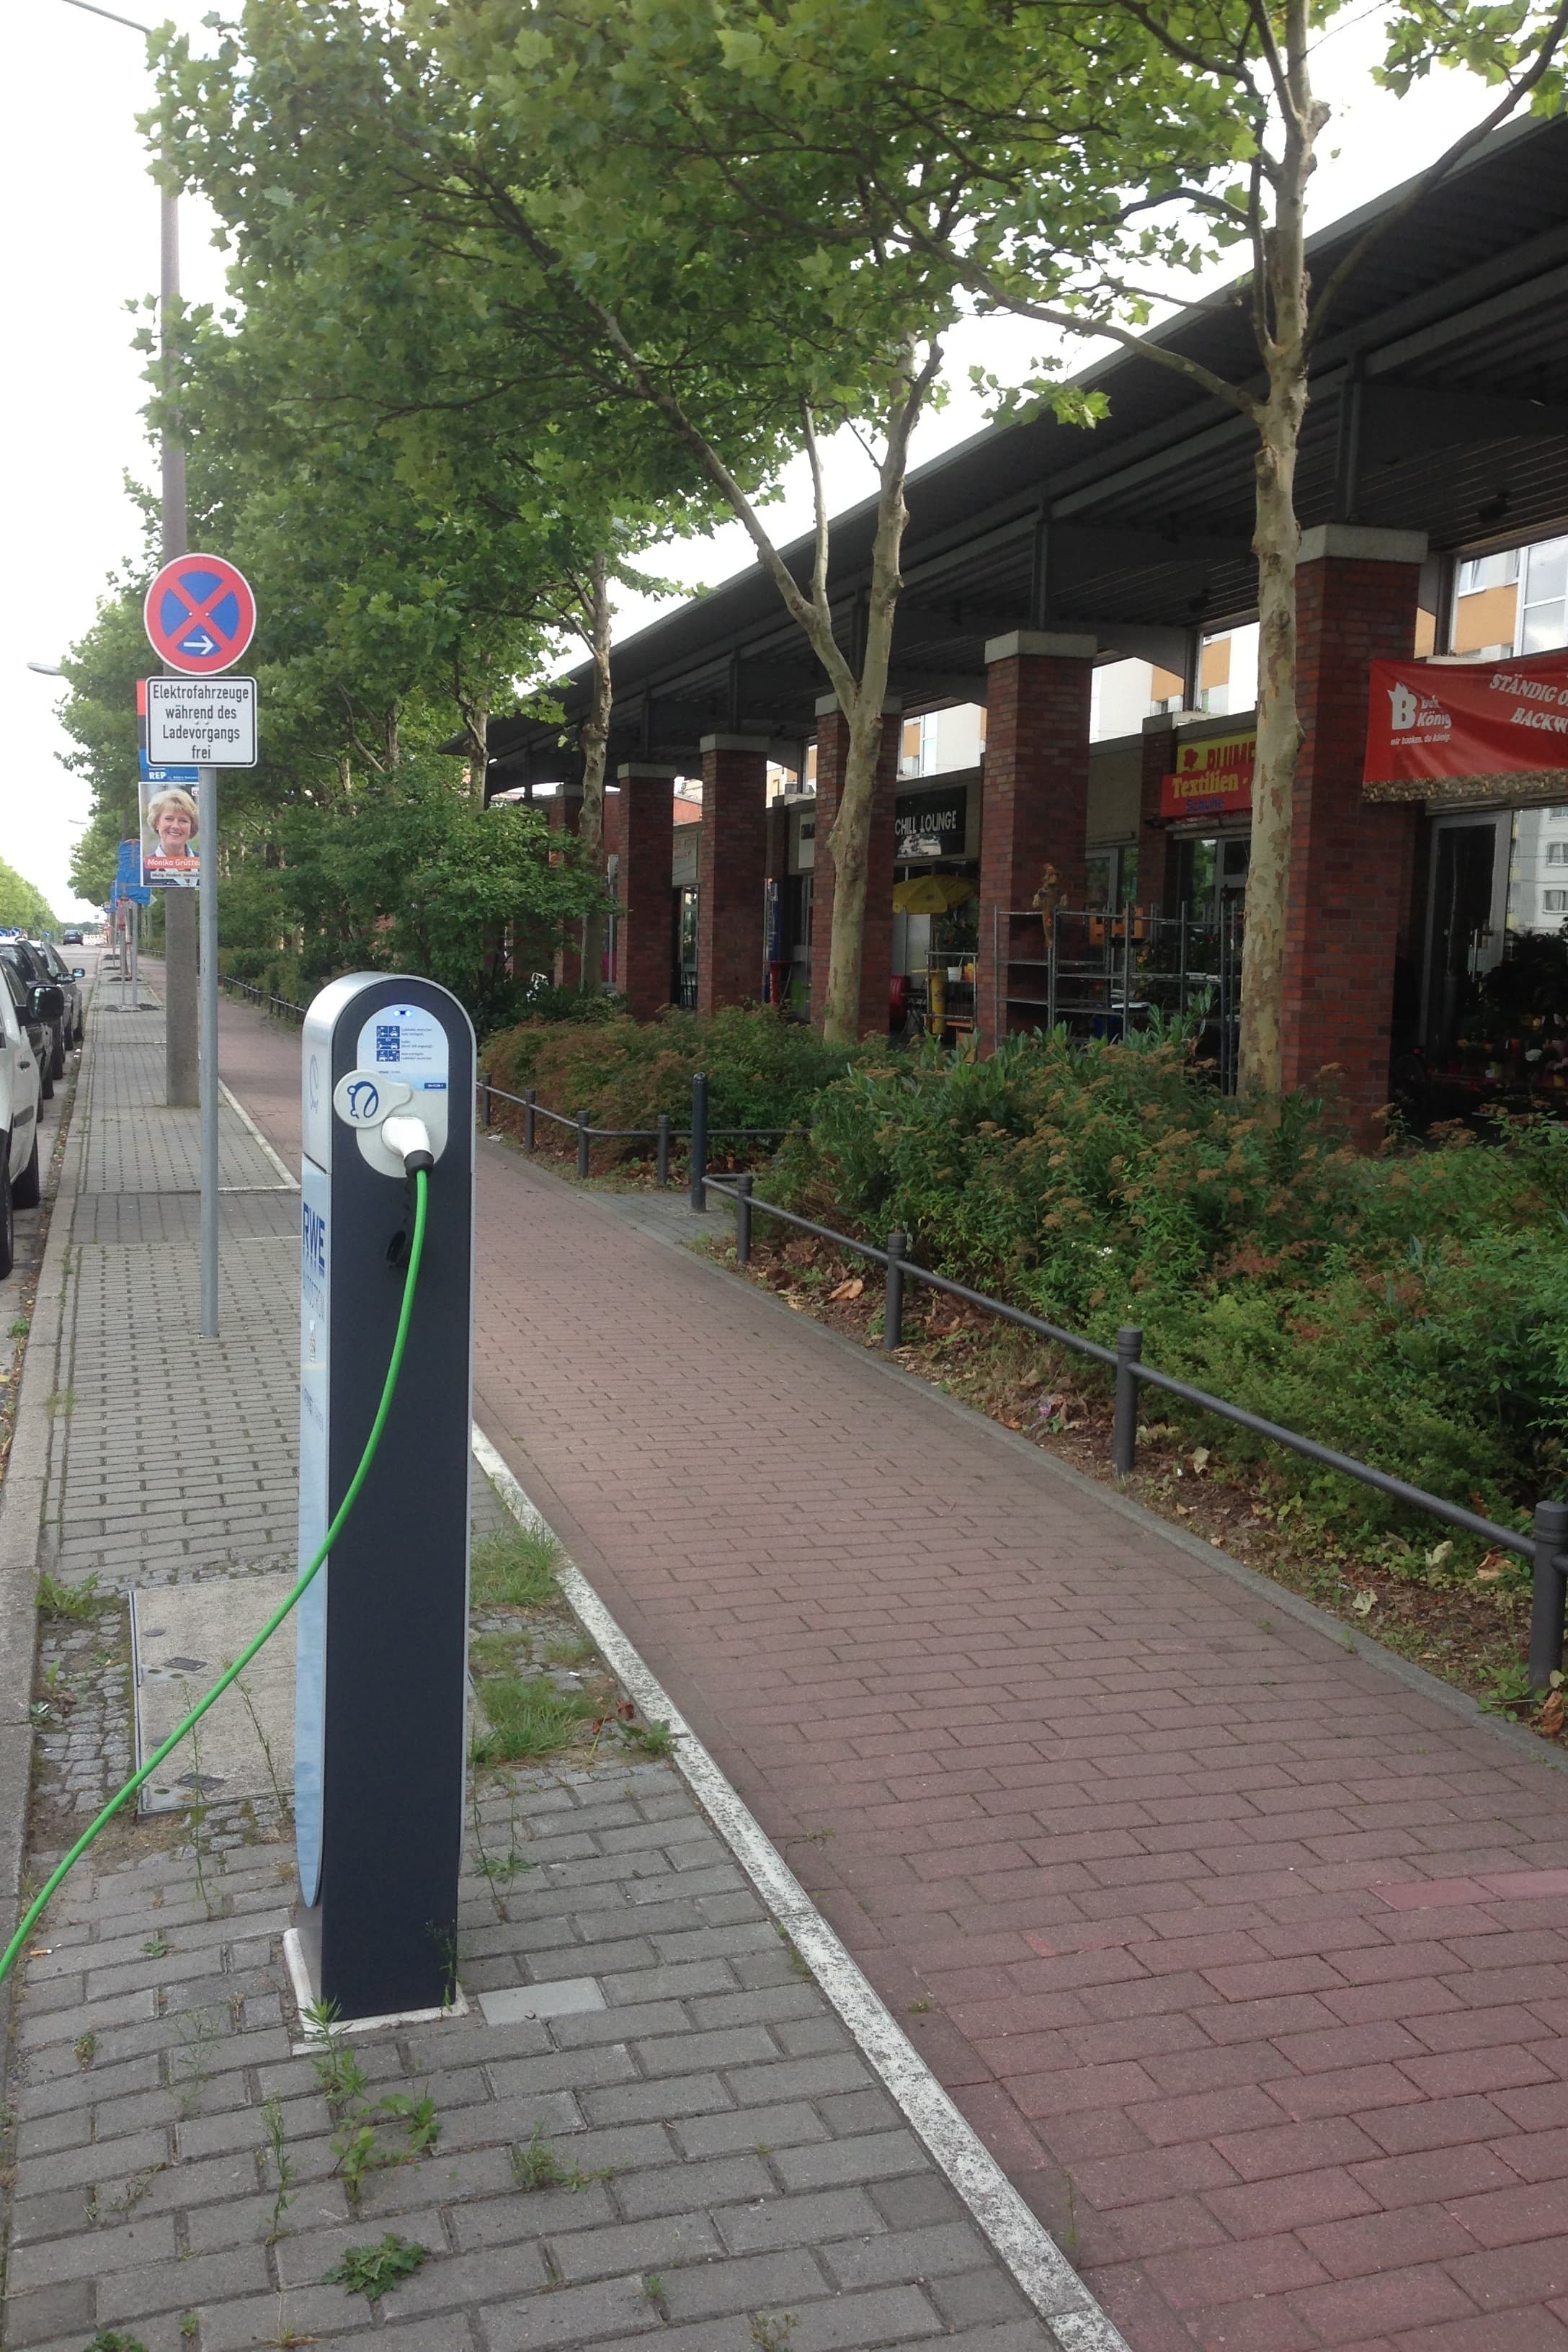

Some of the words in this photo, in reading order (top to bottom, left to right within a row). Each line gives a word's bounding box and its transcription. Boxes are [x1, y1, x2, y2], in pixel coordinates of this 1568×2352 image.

[153, 685, 249, 703] Elektrofahrzeuge
[1489, 674, 1558, 703] STÄNDIG
[1557, 690, 1568, 706] O
[166, 705, 213, 719] während
[218, 705, 237, 719] des
[1417, 710, 1451, 729] König
[1510, 707, 1568, 734] BACKW
[163, 724, 240, 742] Ladevorgangs
[192, 744, 211, 759] frei
[148, 771, 166, 780] REP
[1172, 769, 1239, 799] Textilien
[1187, 797, 1224, 812] Schuhe
[895, 816, 917, 836] CHILL
[919, 810, 957, 833] LOUNGE
[303, 1201, 325, 1268] RWE
